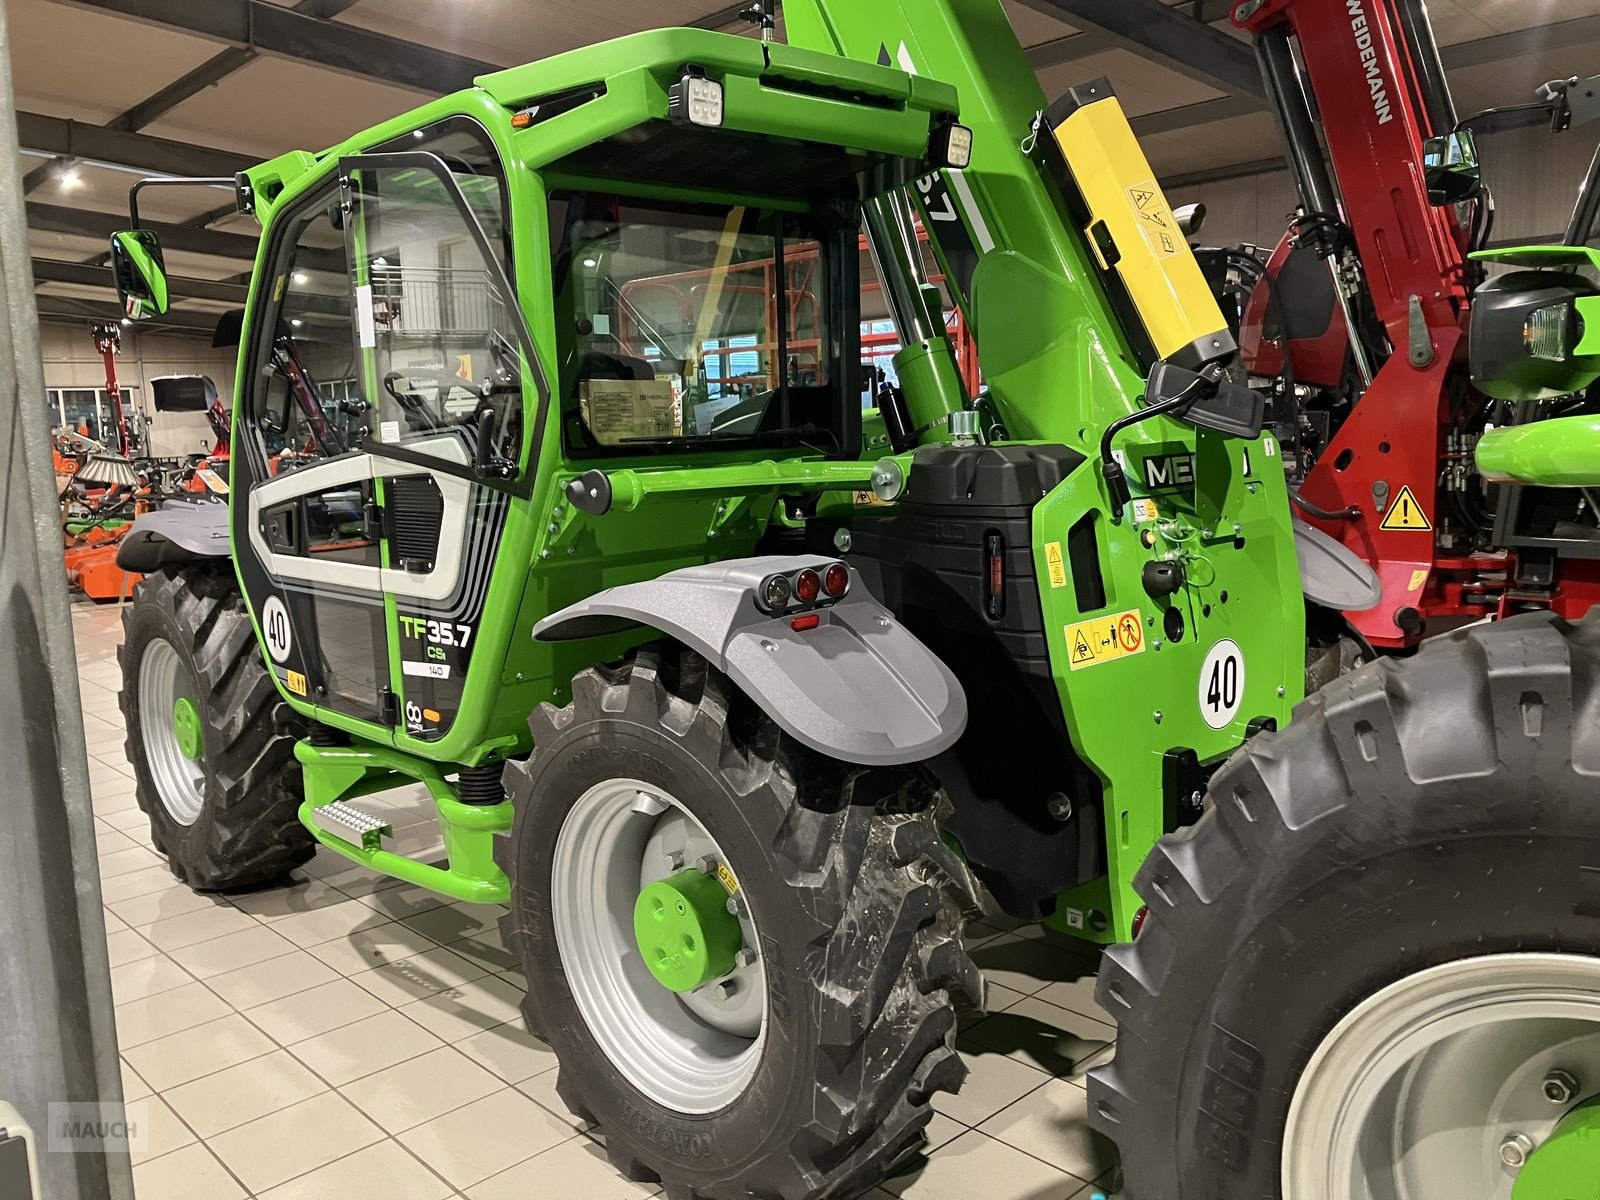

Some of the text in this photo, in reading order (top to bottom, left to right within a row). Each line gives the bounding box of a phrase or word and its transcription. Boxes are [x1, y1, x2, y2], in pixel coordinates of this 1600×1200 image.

[1346, 0, 1393, 125] WEIDEMANN
[269, 610, 286, 651] 40
[1207, 655, 1237, 713] 40
